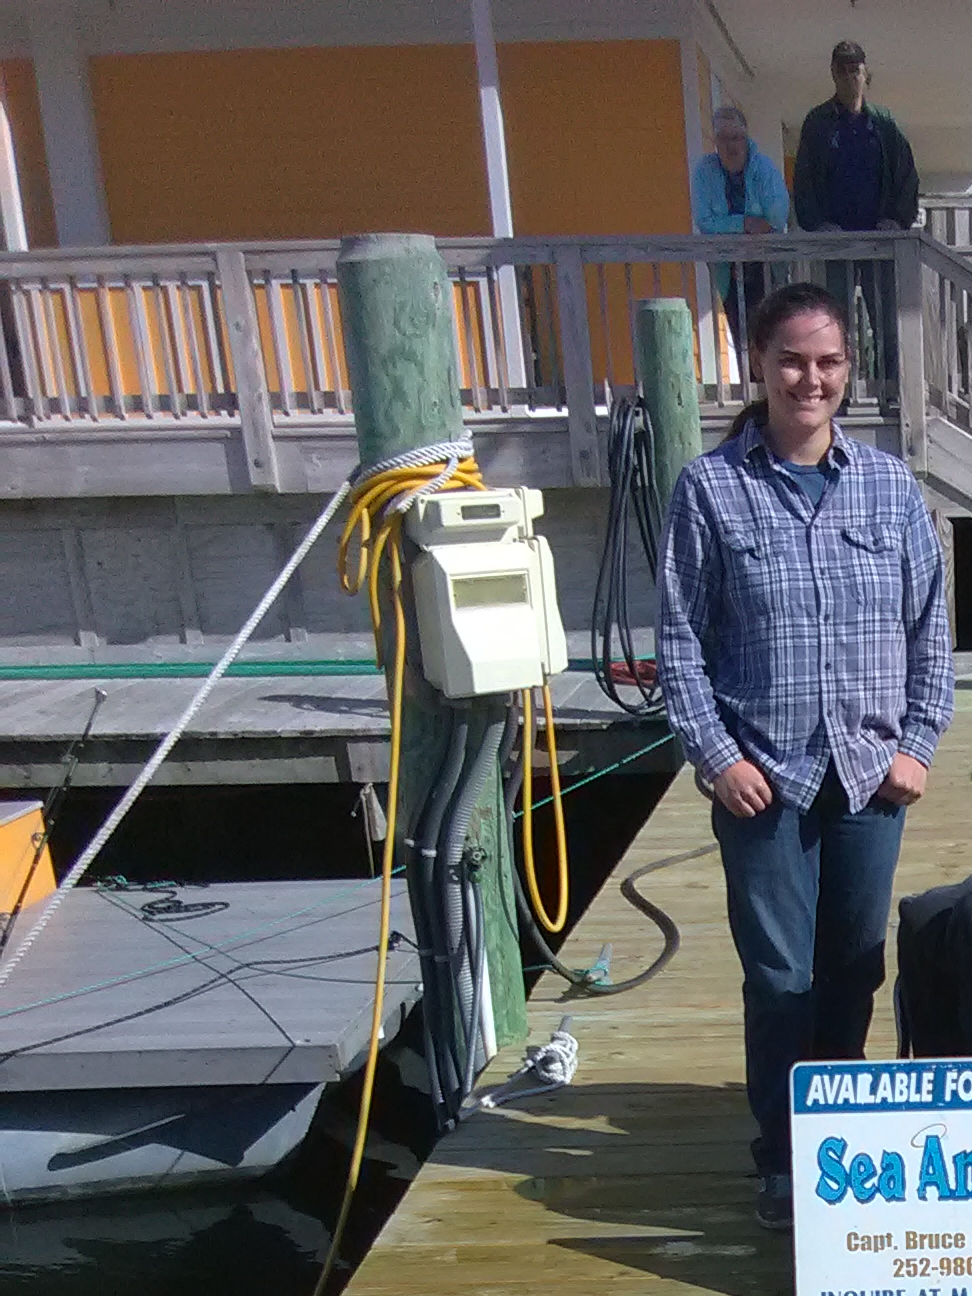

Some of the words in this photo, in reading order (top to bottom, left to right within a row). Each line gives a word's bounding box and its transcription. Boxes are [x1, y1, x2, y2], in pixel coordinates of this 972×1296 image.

[806, 1072, 933, 1106] AVAILABLE
[816, 1137, 906, 1205] Sea
[846, 1232, 898, 1252] Capt.
[905, 1230, 965, 1250] Bruce
